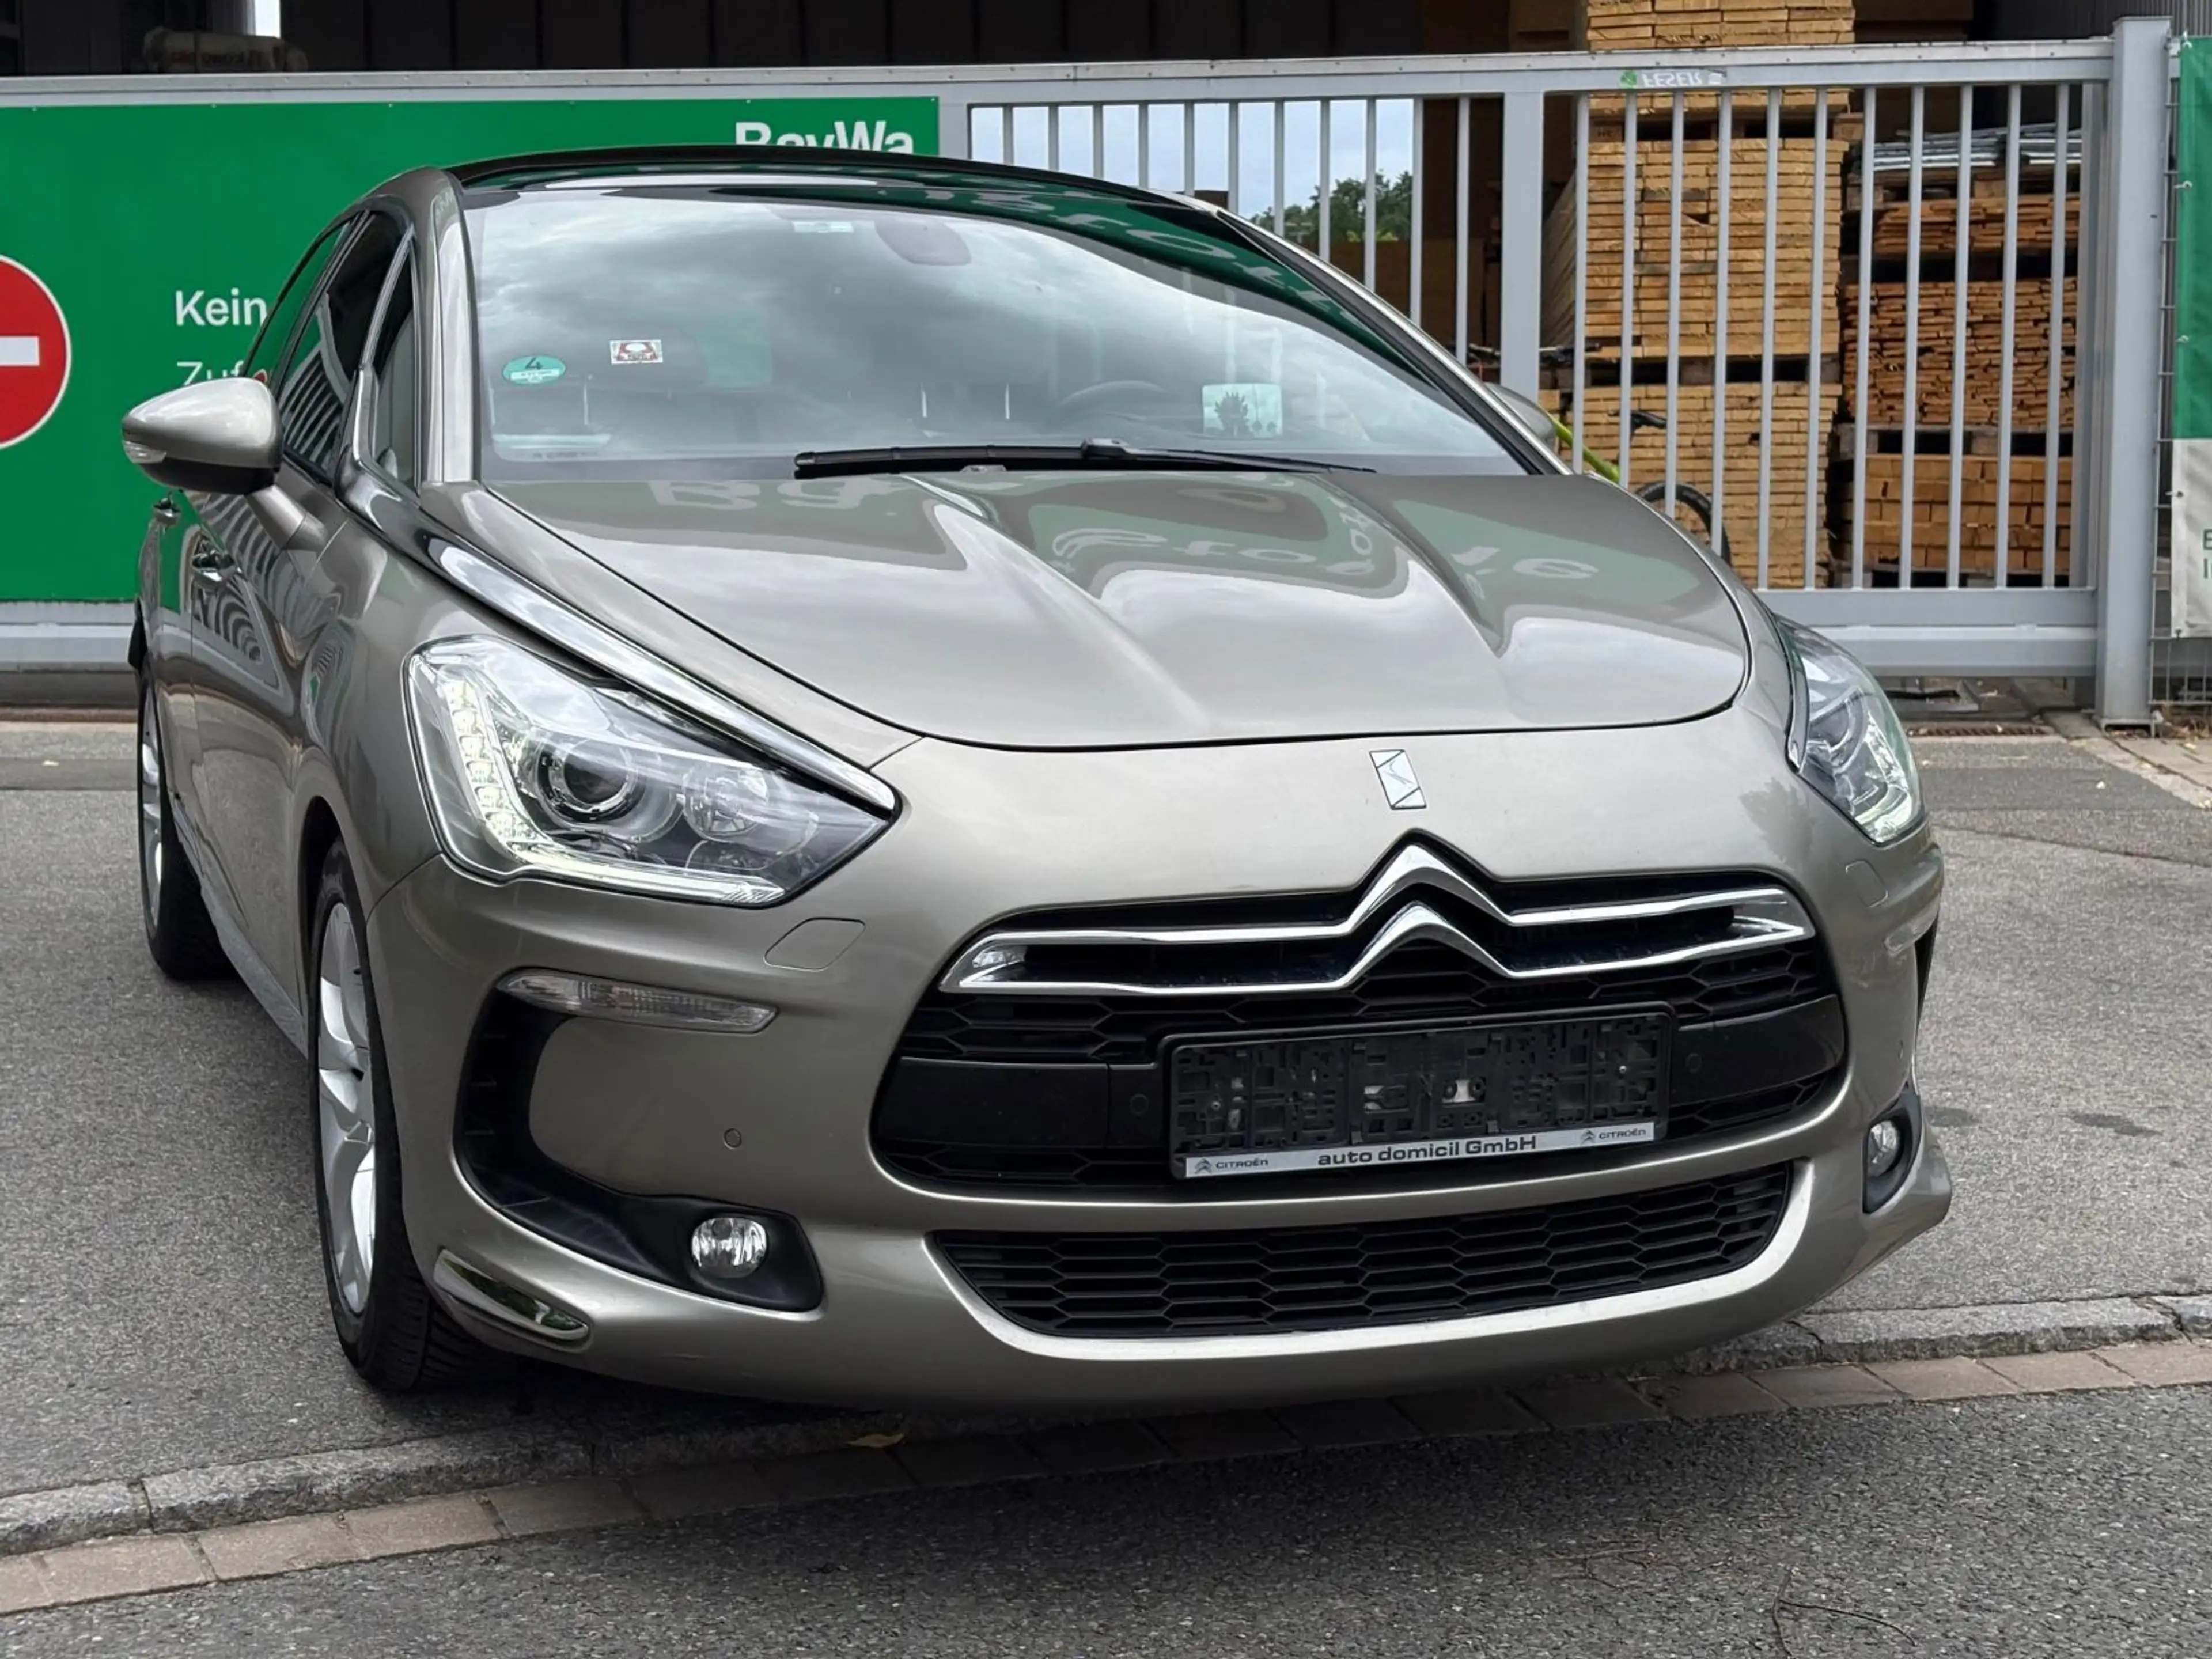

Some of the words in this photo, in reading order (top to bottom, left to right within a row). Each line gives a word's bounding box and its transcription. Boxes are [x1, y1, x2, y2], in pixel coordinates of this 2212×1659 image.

[735, 120, 914, 154] BWa
[175, 287, 267, 327] Kein
[525, 357, 543, 370] 4
[1317, 1151, 1373, 1165] auto
[1378, 1142, 1460, 1162] domicil
[1465, 1135, 1537, 1154] GmbH
